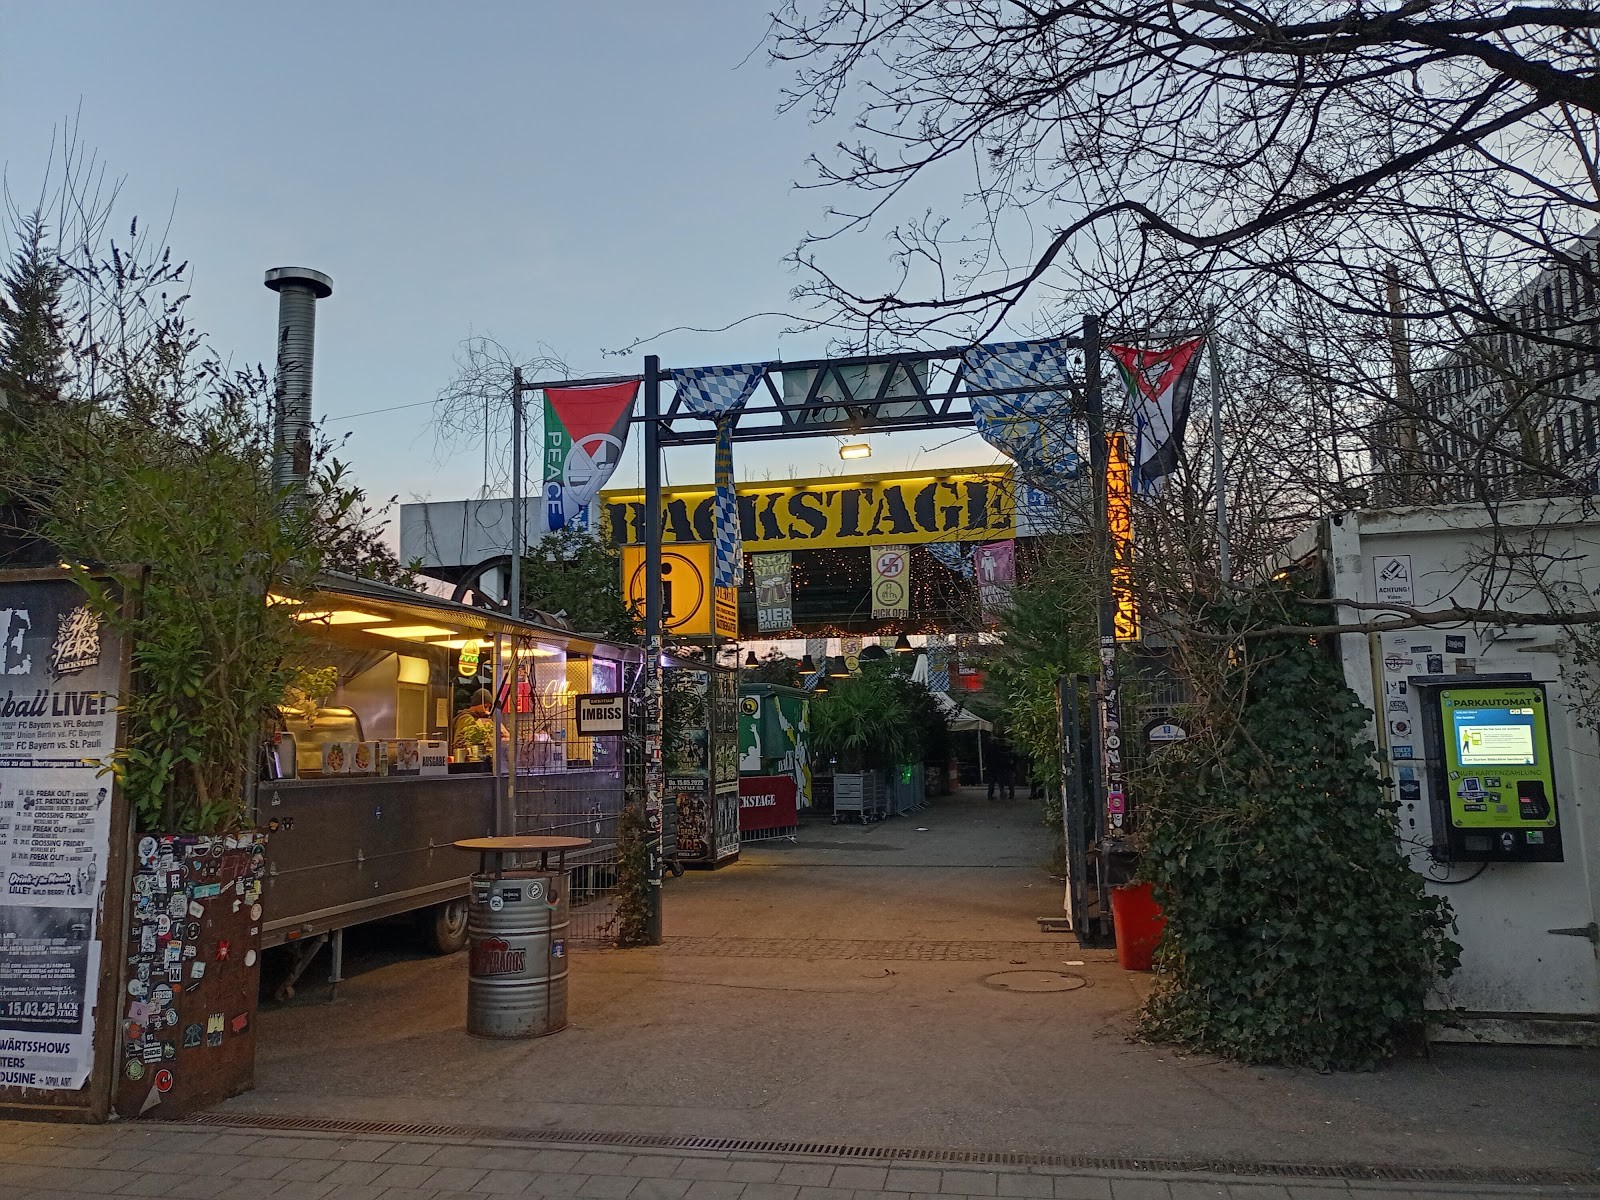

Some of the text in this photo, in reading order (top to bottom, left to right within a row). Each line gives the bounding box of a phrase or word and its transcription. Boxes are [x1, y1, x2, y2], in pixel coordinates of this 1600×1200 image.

[546, 431, 563, 516] PEACE
[758, 608, 792, 622] BIER
[758, 620, 792, 631] GARTEN
[52, 636, 99, 668] YEARS
[58, 658, 98, 671] BACKSTAGE
[0, 690, 106, 718] ball LIVE!
[1453, 698, 1532, 707] PARKAUTOMAT
[582, 707, 622, 721] IMBISS
[18, 721, 27, 729] FC
[28, 721, 51, 730] Bayern
[76, 719, 103, 728] Bochum
[17, 731, 36, 739] Union
[37, 730, 56, 738] Berlin
[68, 729, 77, 737] FC
[78, 729, 101, 738] Bayern
[16, 741, 26, 750] FC
[28, 741, 55, 751] Bayern
[57, 741, 67, 749] vs.
[69, 739, 80, 749] St.
[81, 739, 101, 748] Pauli
[422, 755, 446, 767] AUSGABE
[33, 825, 52, 833] FREAK
[49, 853, 64, 861] OUT
[9, 886, 31, 895] LILLET
[7, 1001, 79, 1017] 15.03.25 BACK
[56, 1009, 79, 1018] STAGE
[61, 1077, 72, 1087] ART
